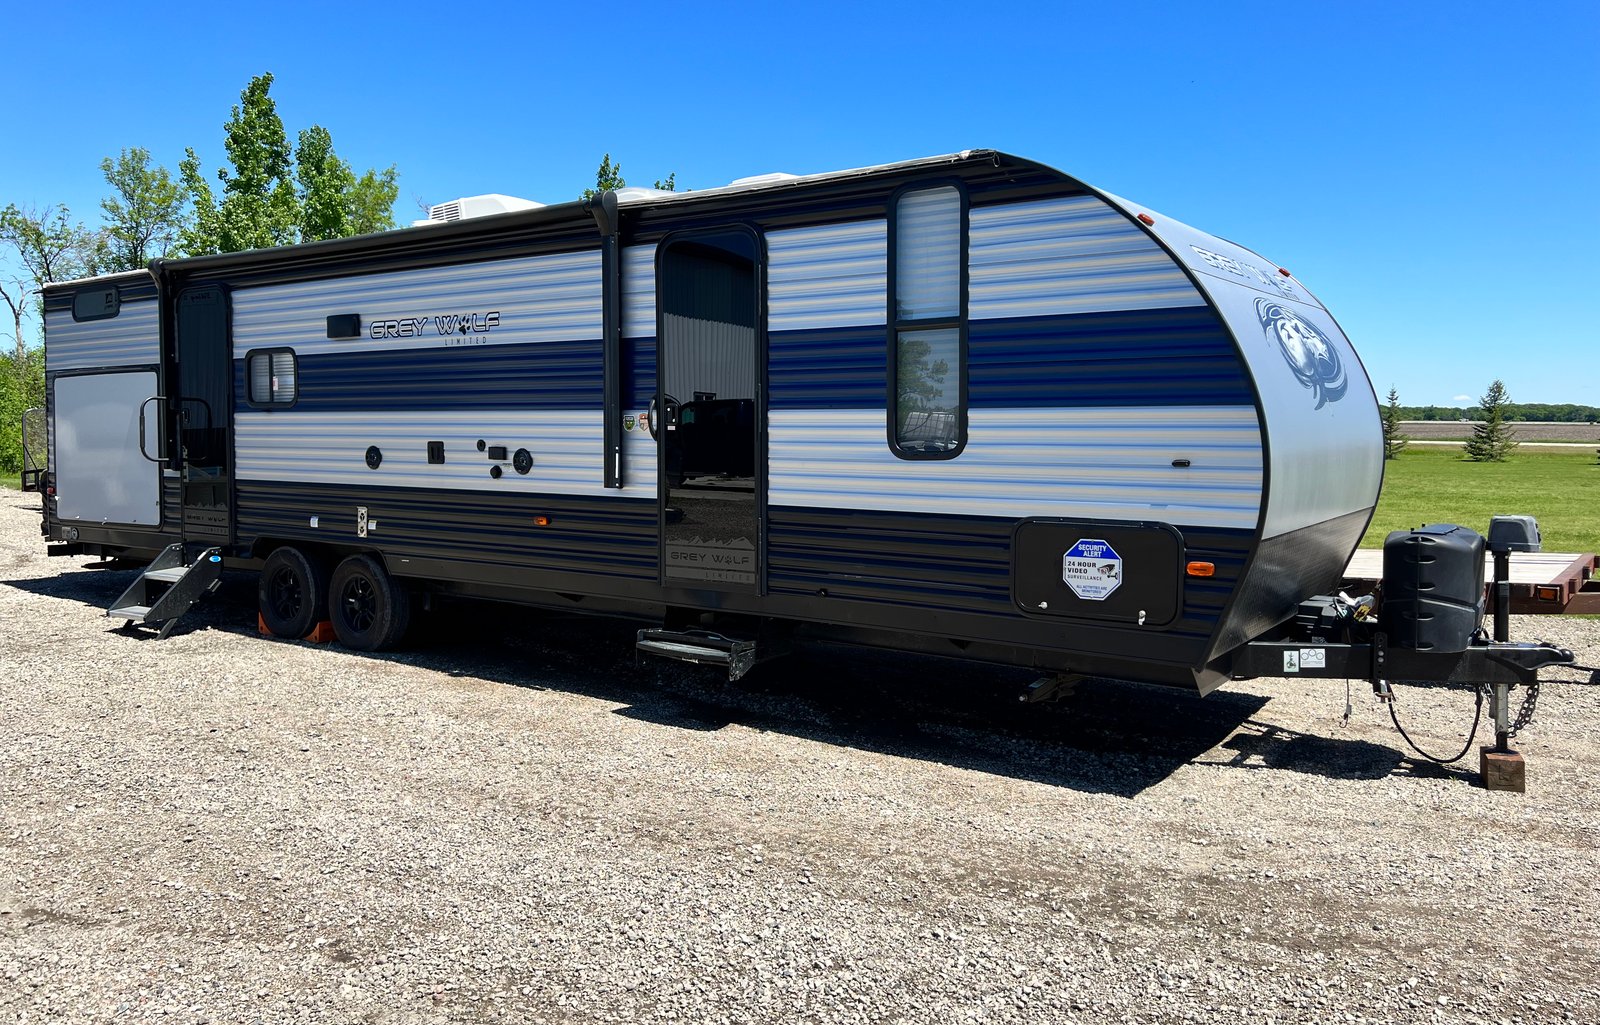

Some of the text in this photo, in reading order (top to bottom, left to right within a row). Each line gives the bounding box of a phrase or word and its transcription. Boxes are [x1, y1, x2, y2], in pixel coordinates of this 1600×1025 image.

[370, 317, 428, 339] GREY
[444, 336, 487, 346] LIMITED
[1078, 544, 1107, 552] SECURITY
[670, 551, 706, 562] GREY
